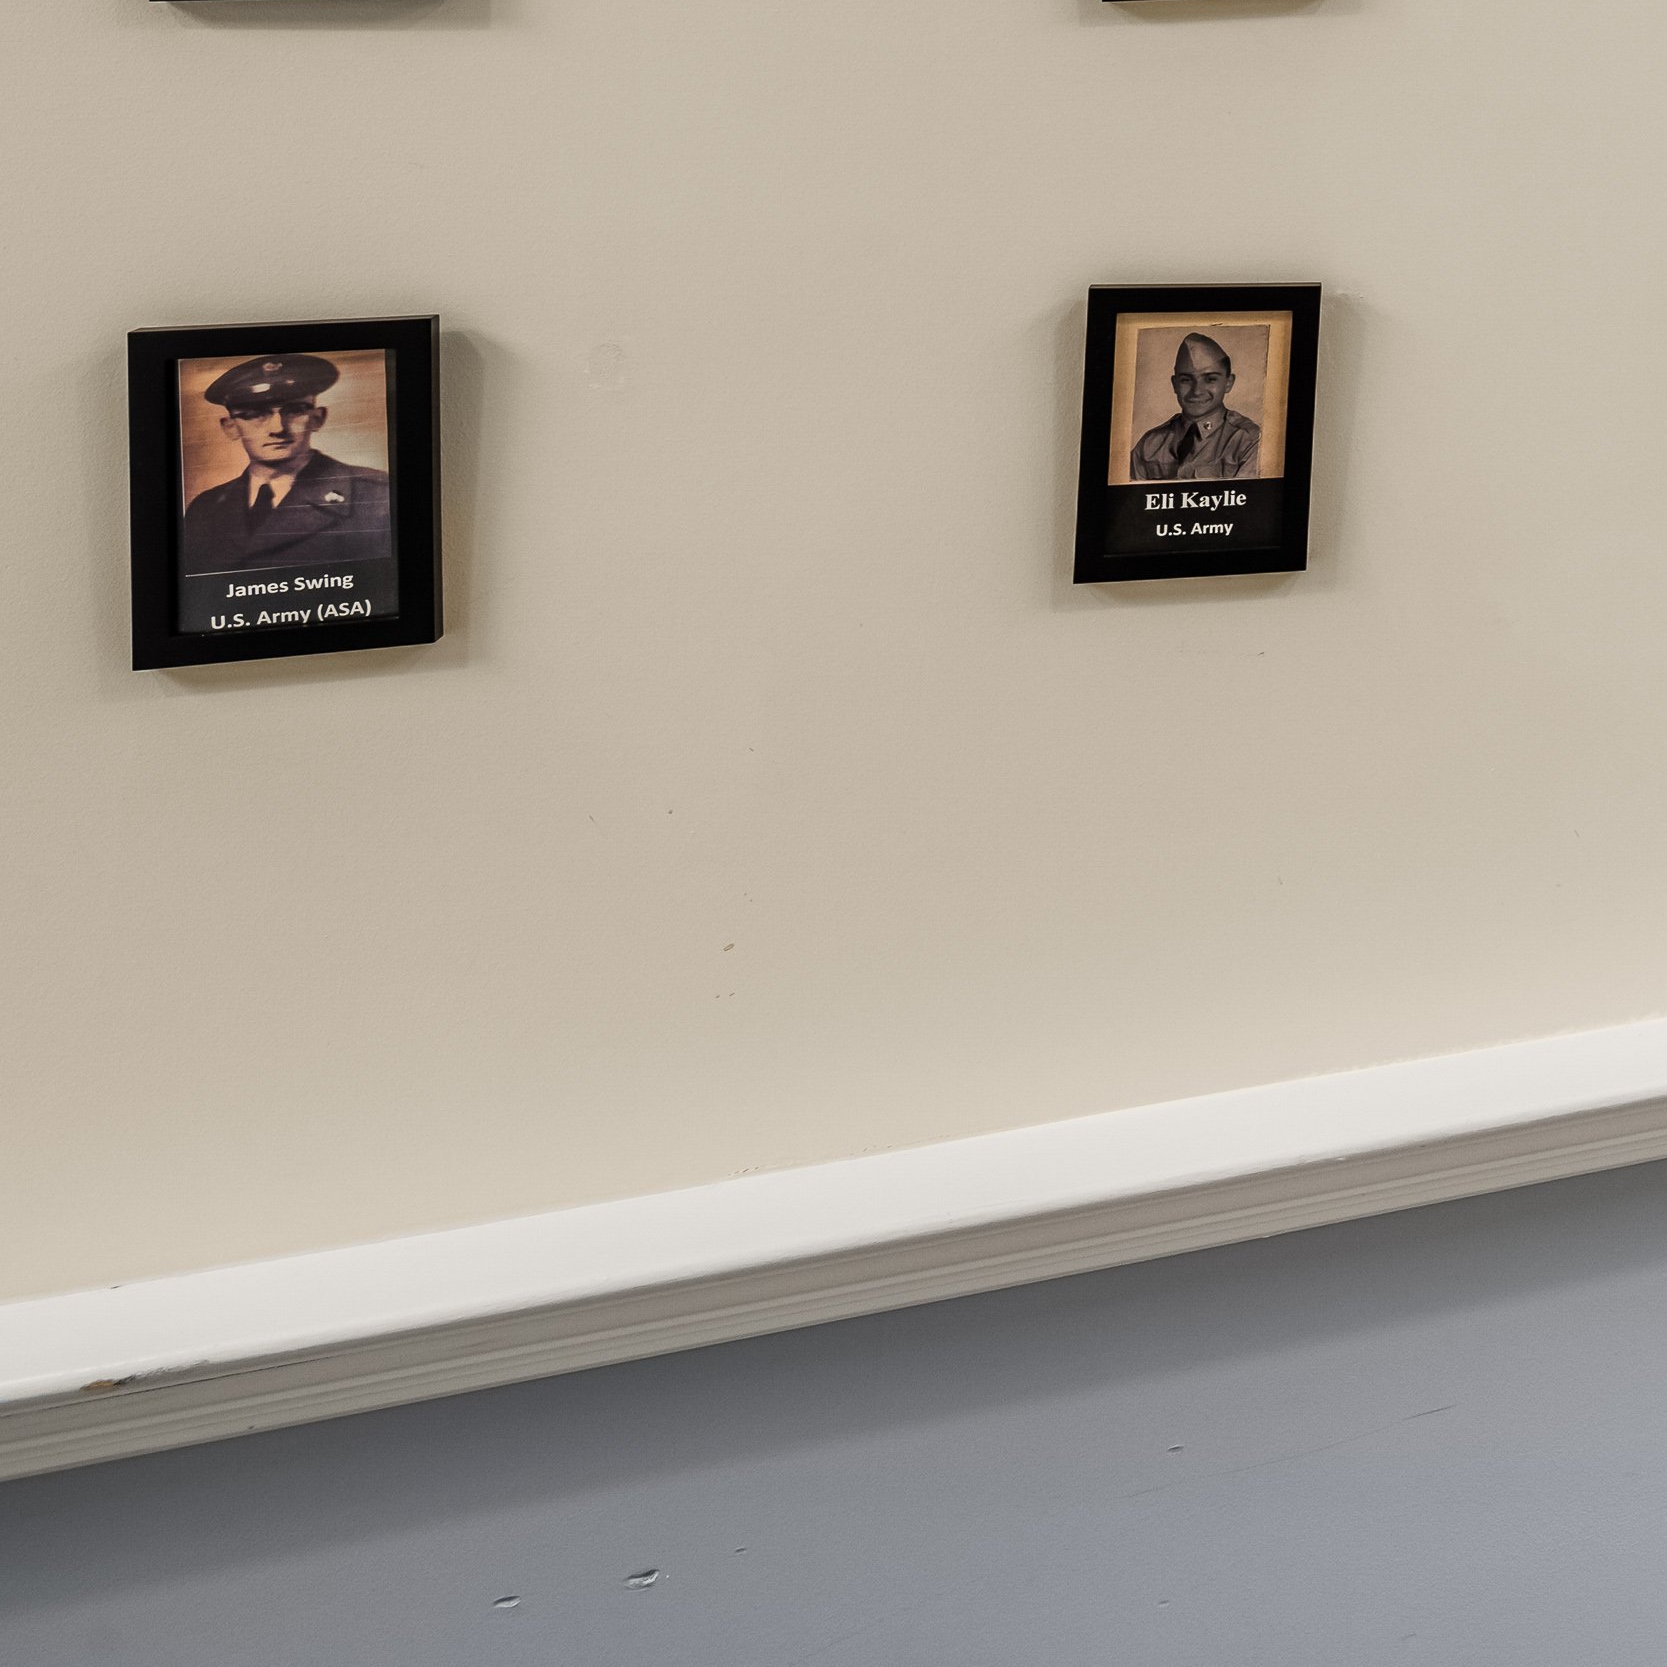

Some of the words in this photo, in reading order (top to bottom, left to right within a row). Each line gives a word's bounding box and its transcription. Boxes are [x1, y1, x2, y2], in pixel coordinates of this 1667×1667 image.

[1144, 493, 1175, 511] Eli
[1180, 490, 1247, 512] Kaylie
[1156, 523, 1187, 537] U.S.
[1190, 522, 1234, 536] Army
[226, 582, 289, 599] James
[294, 573, 354, 591] Swing
[210, 615, 251, 630] U.S.
[256, 608, 312, 626] Army
[317, 599, 372, 622] (ASA)
